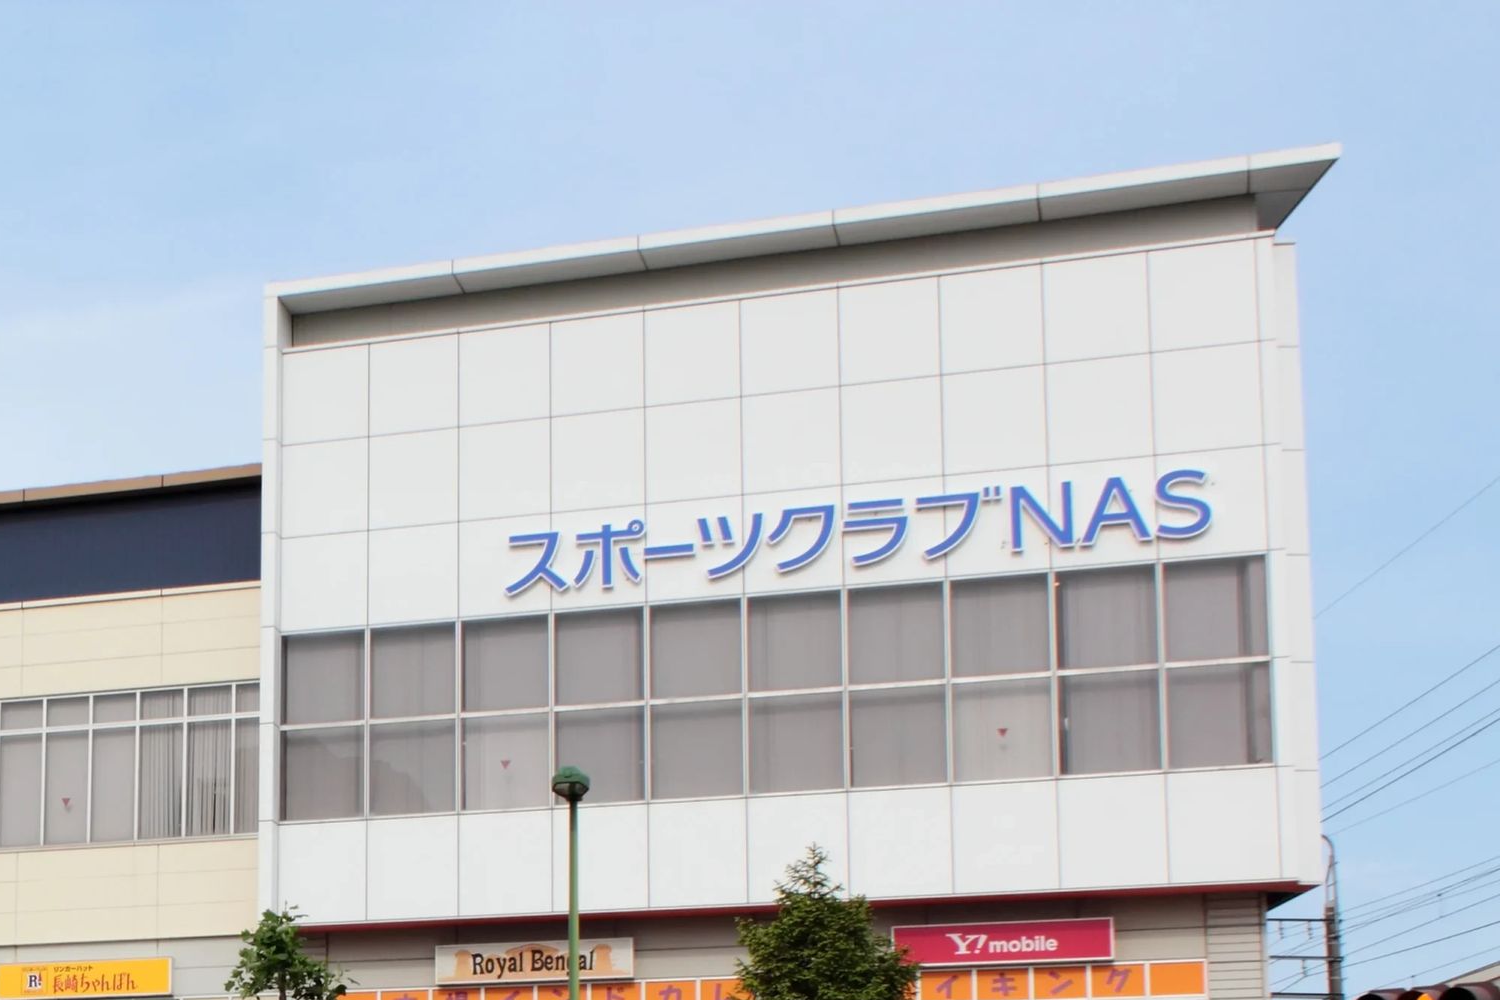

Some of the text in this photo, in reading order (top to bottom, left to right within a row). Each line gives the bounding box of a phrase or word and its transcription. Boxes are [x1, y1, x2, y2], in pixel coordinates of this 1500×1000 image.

[505, 468, 1216, 598] スポーツクラブNAS
[472, 948, 595, 979] Royal Benal
[53, 973, 137, 994] 長崎ちゃんぽん
